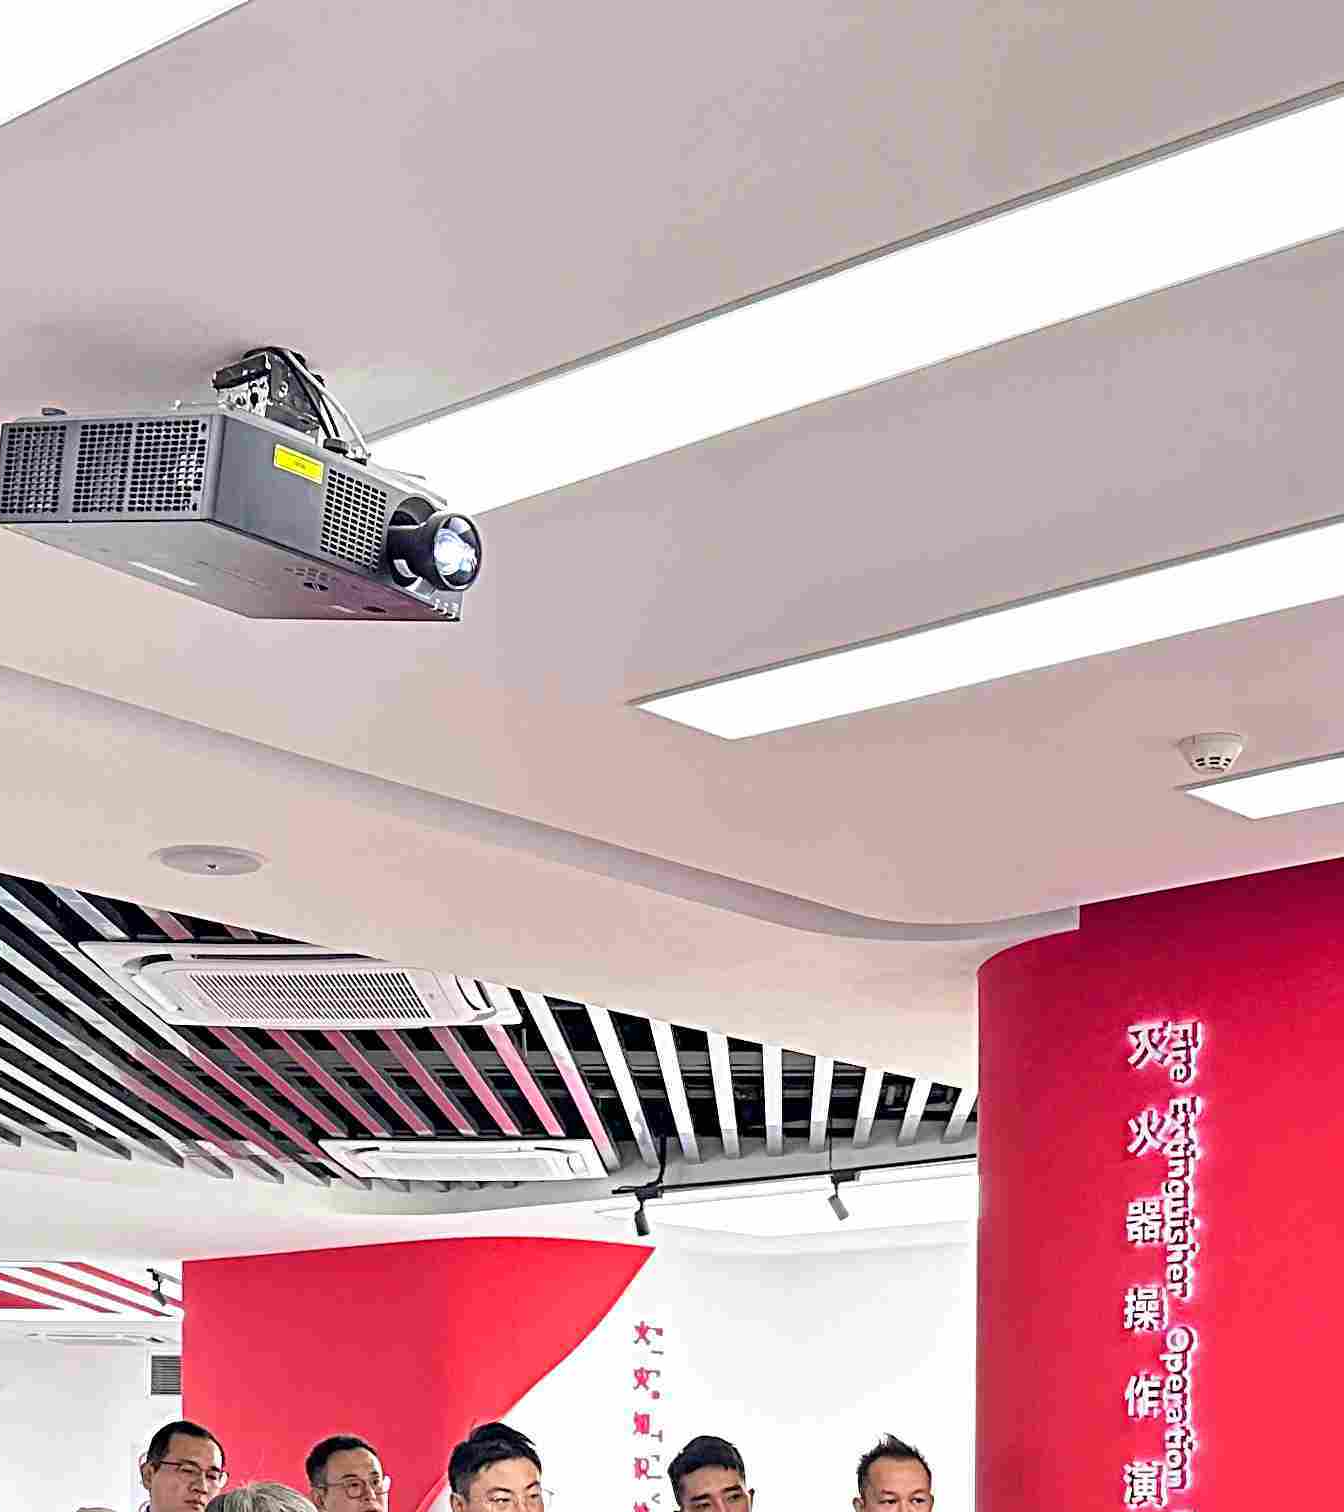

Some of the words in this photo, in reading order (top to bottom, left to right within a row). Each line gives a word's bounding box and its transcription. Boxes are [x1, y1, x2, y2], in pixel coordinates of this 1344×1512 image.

[1167, 1021, 1202, 1083] Fire
[1161, 1096, 1201, 1298] Extinguisher
[1160, 1327, 1198, 1489] Operation
